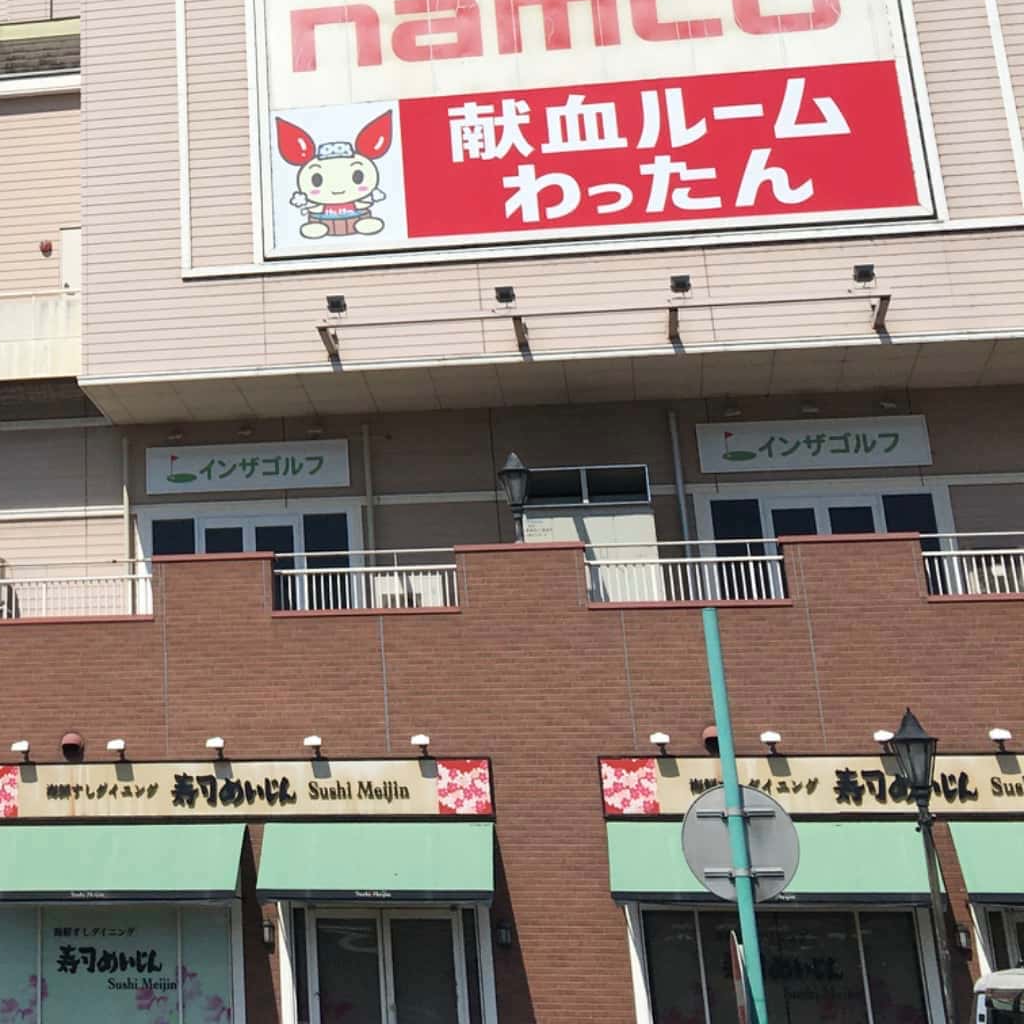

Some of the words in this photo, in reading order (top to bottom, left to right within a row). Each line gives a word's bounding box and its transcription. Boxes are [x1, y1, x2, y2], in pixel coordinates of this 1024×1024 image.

[448, 77, 852, 163] 献血ルーム
[503, 148, 814, 224] わったん
[758, 432, 900, 458] インザゴルフ
[199, 455, 325, 481] インザゴルフ
[170, 771, 298, 809] 寿司めいじん
[308, 779, 353, 801] Sushi
[357, 778, 411, 804] Meijin
[56, 944, 163, 974] 寿司めいじん
[108, 977, 138, 990] Sushi
[142, 977, 177, 992] Meijin
